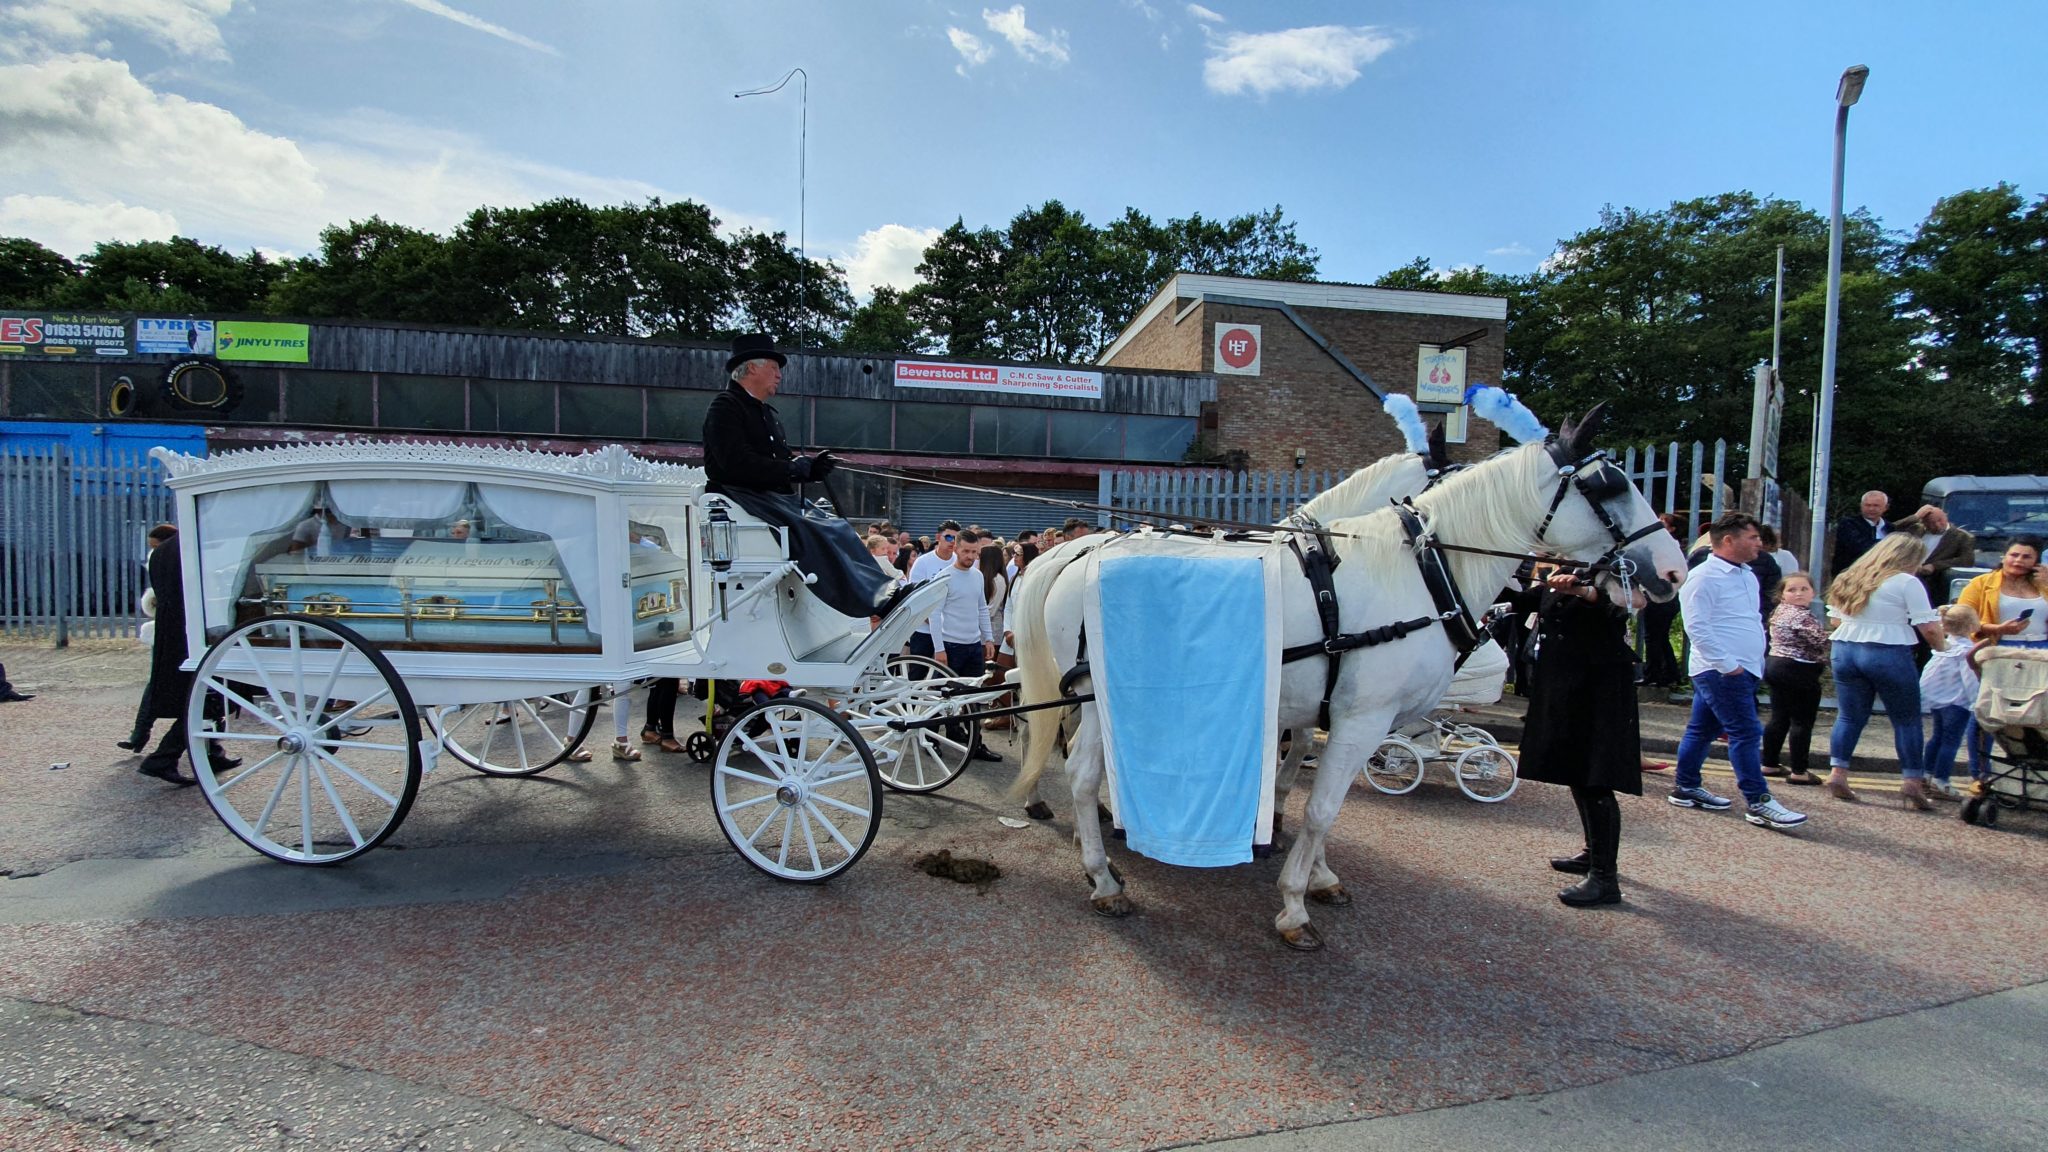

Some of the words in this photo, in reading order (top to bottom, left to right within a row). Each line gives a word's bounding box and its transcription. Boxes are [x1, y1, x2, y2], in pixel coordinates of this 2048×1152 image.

[52, 314, 70, 323] New
[71, 315, 79, 323] &
[81, 315, 97, 324] Part
[0, 317, 43, 345] ES
[44, 324, 81, 337] 01633
[83, 325, 125, 338] 547676
[235, 338, 271, 347] JINYU
[273, 338, 306, 348] TIRES
[899, 366, 968, 379] Beverstock
[972, 370, 996, 381] Ltd.
[1036, 373, 1054, 381] Saw
[1065, 375, 1093, 384] Cutter
[1002, 378, 1051, 390] Sharpening
[1053, 381, 1099, 392] Specialists
[347, 553, 396, 564] Thomas
